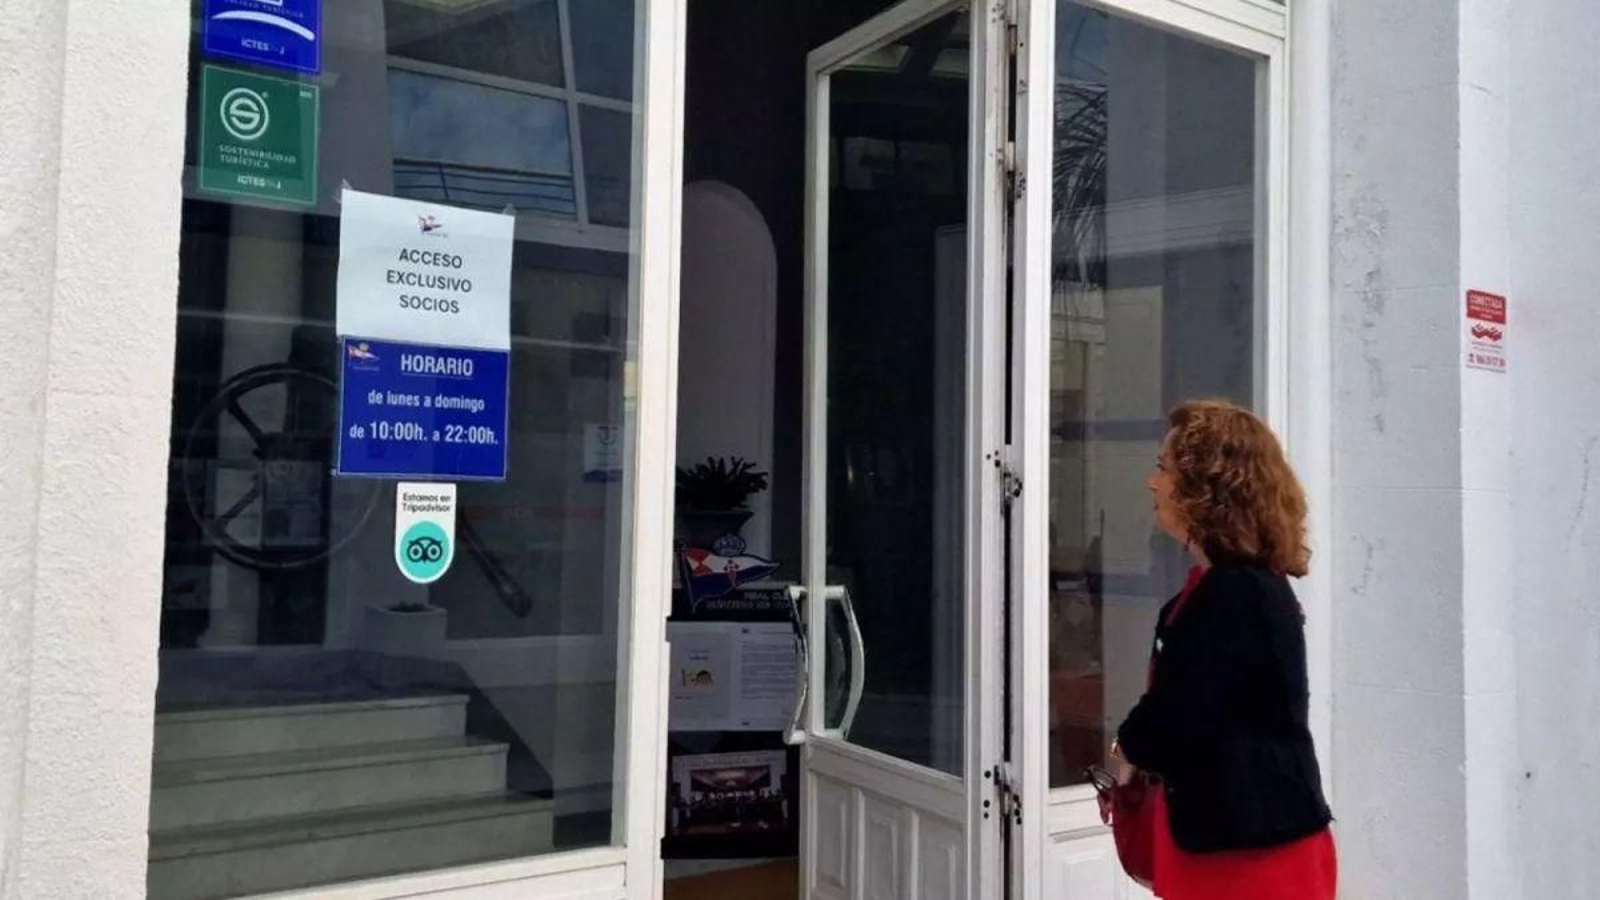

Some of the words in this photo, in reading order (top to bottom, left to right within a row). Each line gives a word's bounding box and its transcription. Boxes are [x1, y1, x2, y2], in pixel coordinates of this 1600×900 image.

[219, 144, 297, 165] SOSTENIBILIDAD
[399, 248, 463, 269] ACCESO
[386, 269, 472, 293] EXCLUSIVO
[399, 295, 460, 314] SOCIOS
[401, 354, 474, 376] HORARIO
[368, 390, 383, 405] de
[423, 397, 431, 408] a
[435, 394, 485, 413] domingo
[350, 424, 365, 439] de
[370, 421, 428, 441] 10:00h.
[433, 430, 440, 442] a
[445, 425, 499, 445] 22:00h.
[403, 492, 438, 502] Estamos
[403, 502, 451, 513] Tripadvisor
